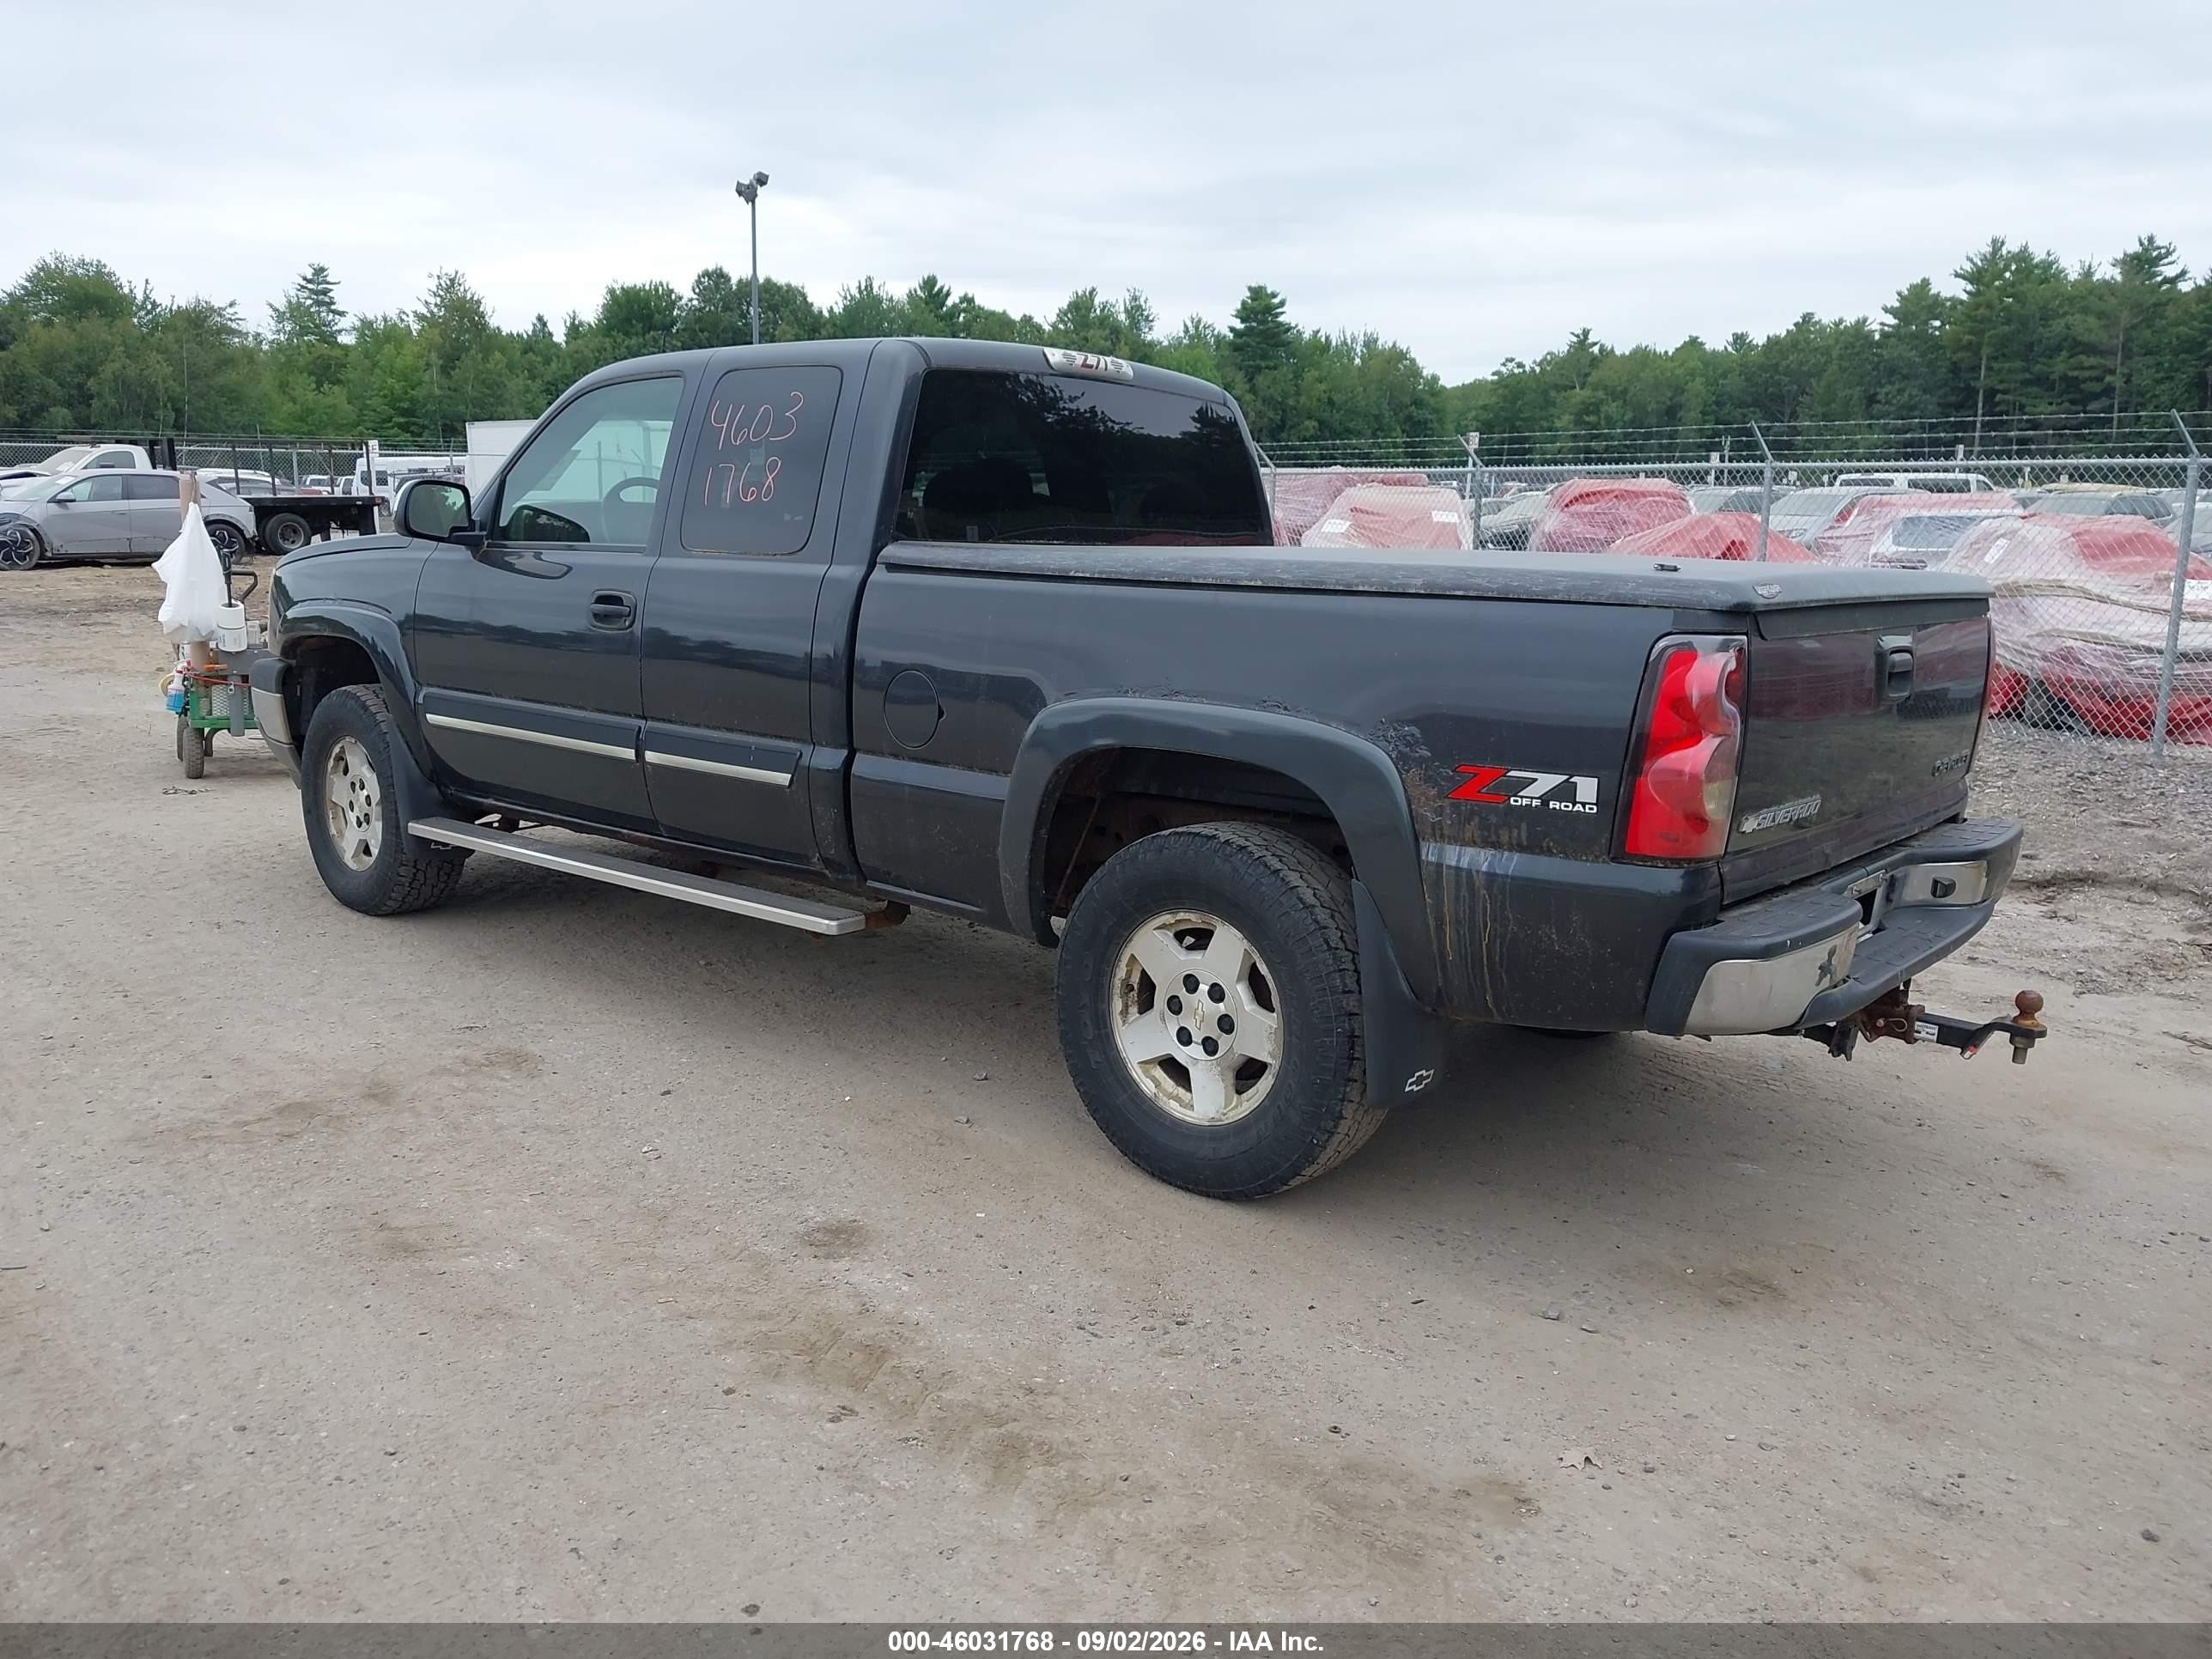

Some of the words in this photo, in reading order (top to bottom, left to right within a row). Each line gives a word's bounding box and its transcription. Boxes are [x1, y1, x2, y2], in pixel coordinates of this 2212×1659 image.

[710, 391, 804, 451] 4603
[704, 456, 782, 507] 1768
[1446, 764, 1599, 805] Z71
[1510, 796, 1542, 808] OFF
[1548, 800, 1598, 814] ROAD
[1756, 799, 1822, 830] SILVERADO
